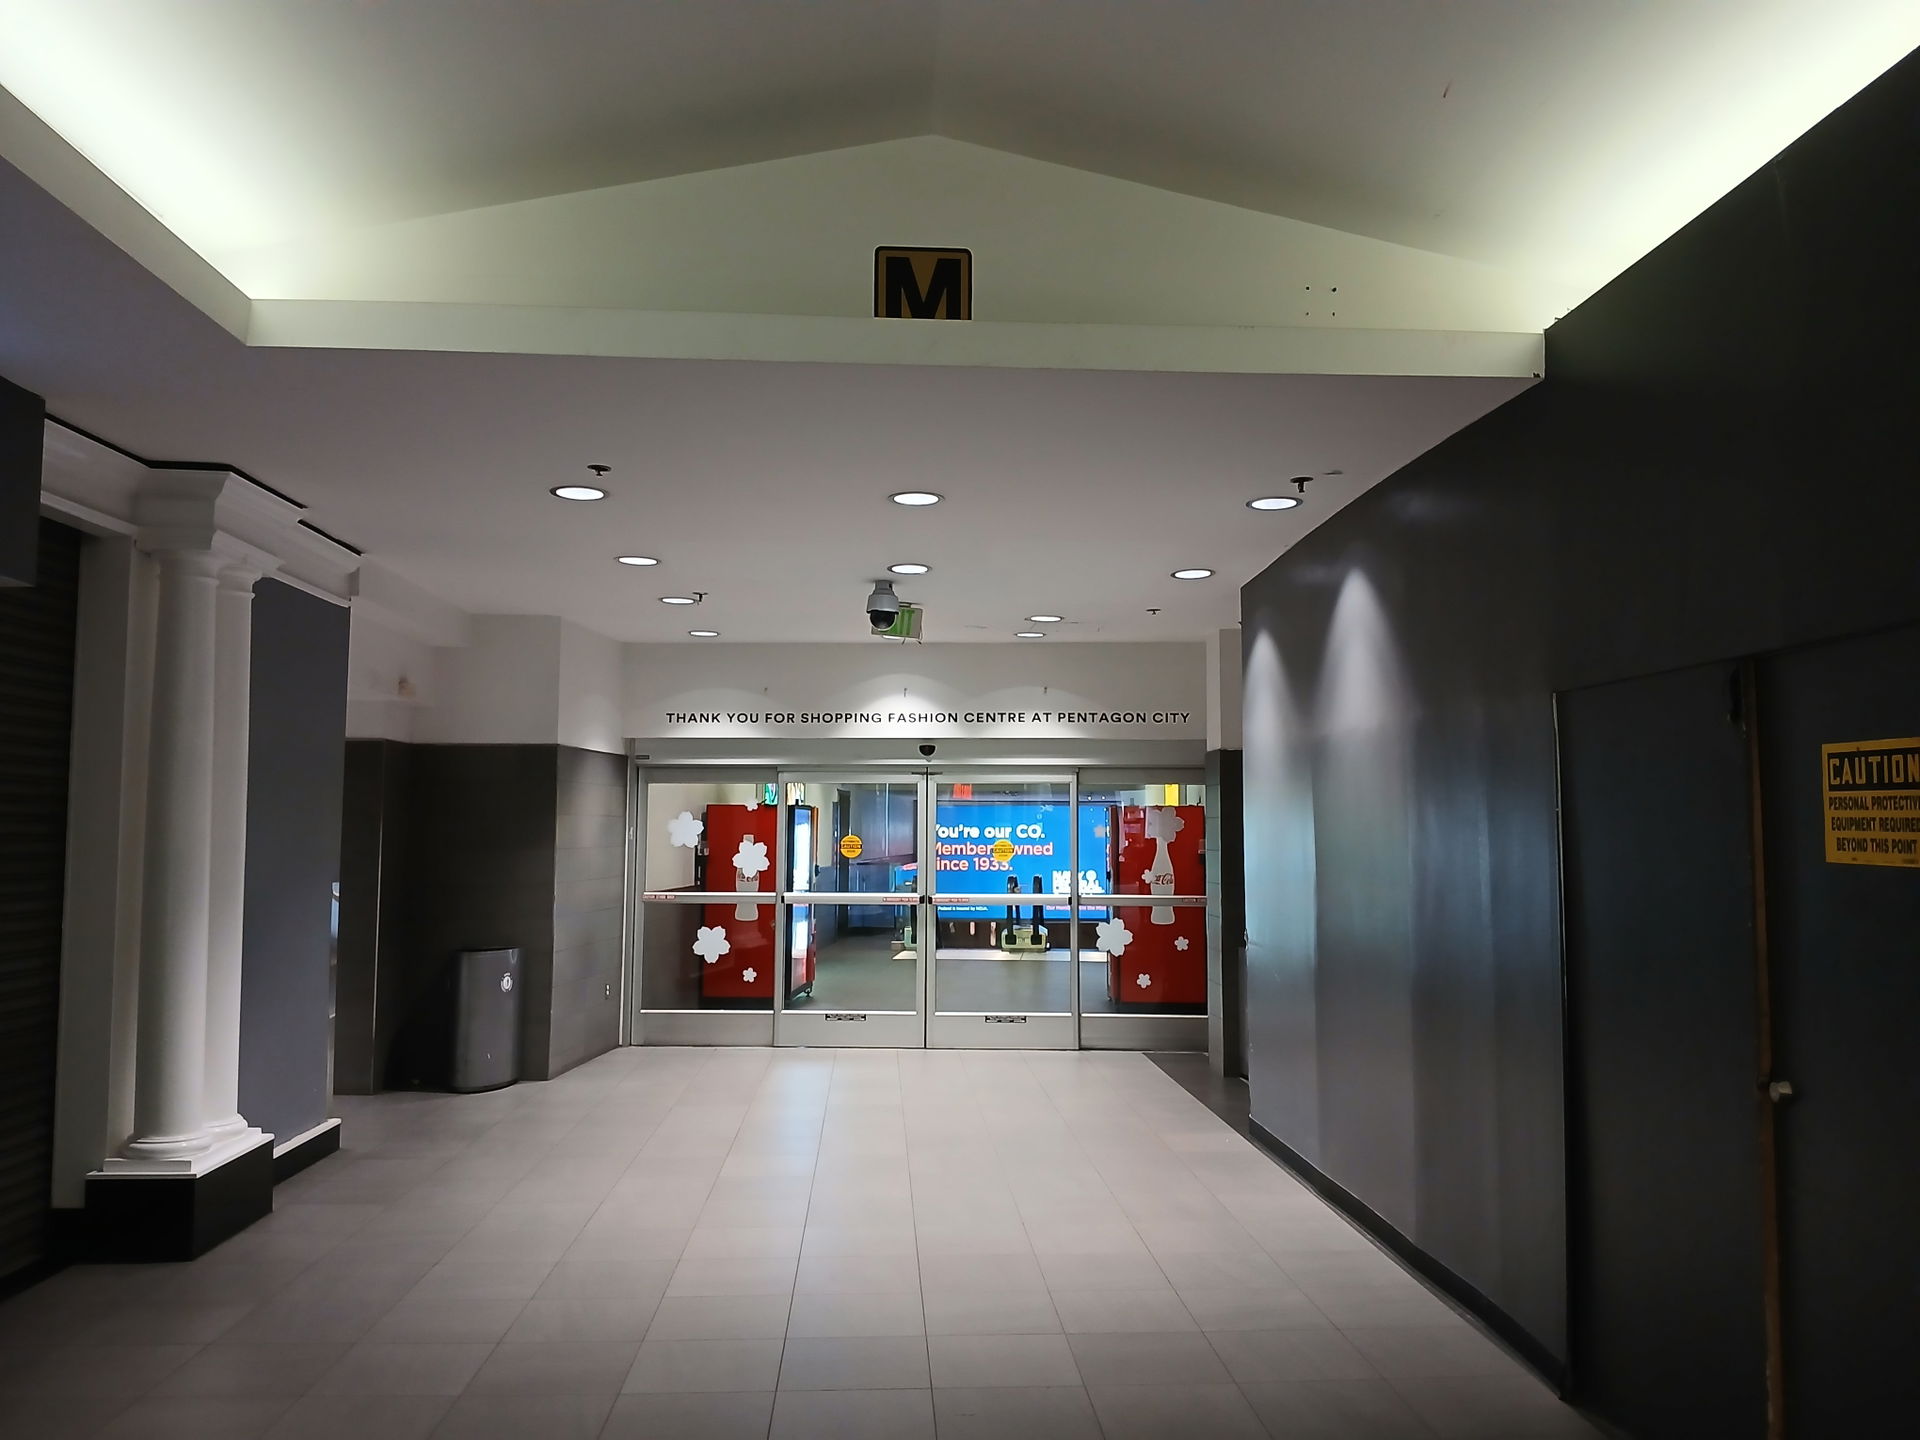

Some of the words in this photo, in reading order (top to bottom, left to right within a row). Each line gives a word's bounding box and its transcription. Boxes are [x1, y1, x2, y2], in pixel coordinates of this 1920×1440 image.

[886, 257, 961, 319] M
[666, 712, 721, 724] THANK
[726, 712, 759, 724] YOU
[765, 712, 795, 724] FOR
[800, 712, 882, 724] SHOPPING
[888, 712, 958, 724] FASHION
[964, 712, 1026, 724] CENTRE
[1031, 712, 1052, 724] AT
[1057, 712, 1147, 724] PENTAGON
[1152, 712, 1191, 724] CITY
[1830, 754, 1920, 784] CAUTION
[1828, 796, 1869, 811] PERSONAL
[984, 826, 1012, 838] our
[1831, 817, 1876, 832] EQUIPMENT
[1836, 837, 1868, 852] BEYOND
[1870, 838, 1889, 853] THIS
[1892, 838, 1918, 854] POINT
[936, 857, 969, 870] ince
